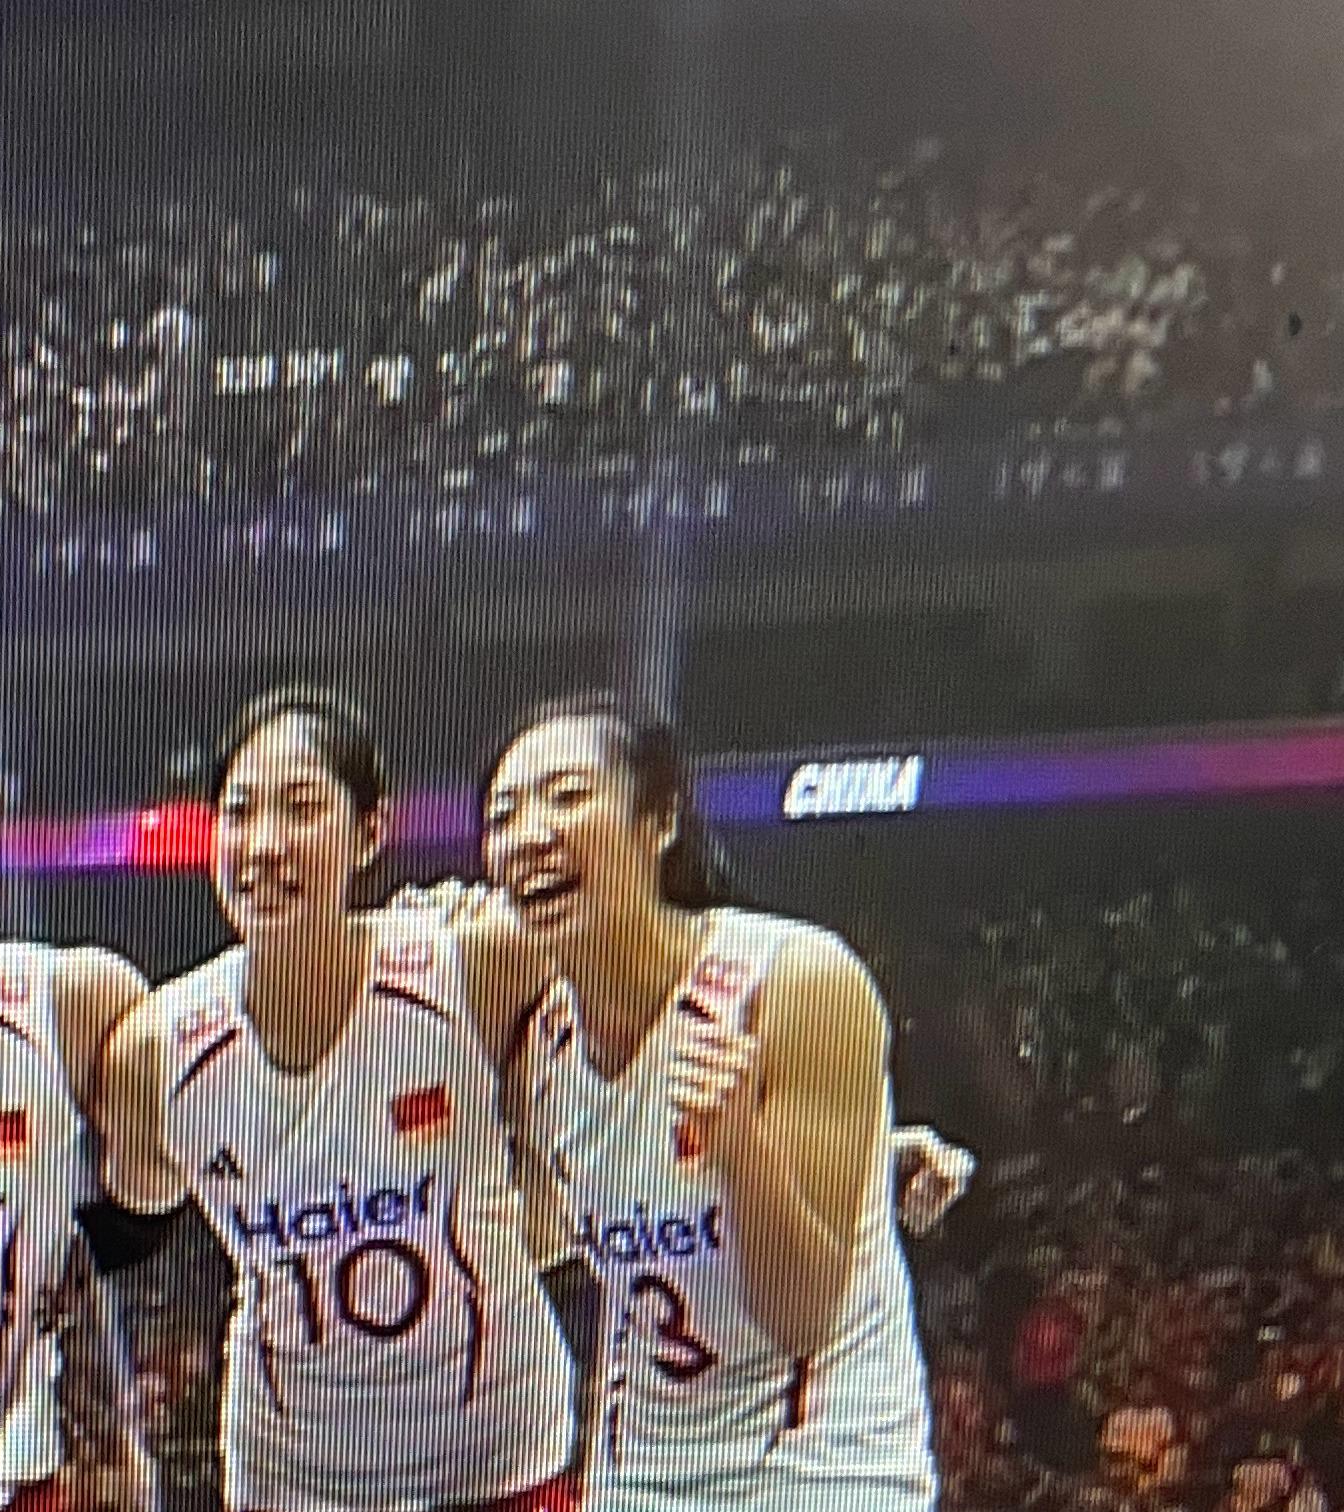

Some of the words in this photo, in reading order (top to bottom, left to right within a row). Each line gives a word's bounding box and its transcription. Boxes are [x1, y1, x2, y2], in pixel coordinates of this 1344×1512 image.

[783, 755, 924, 820] CHINA
[231, 1168, 435, 1248] Haier
[274, 1237, 429, 1344] 10
[630, 1273, 719, 1382] 3
